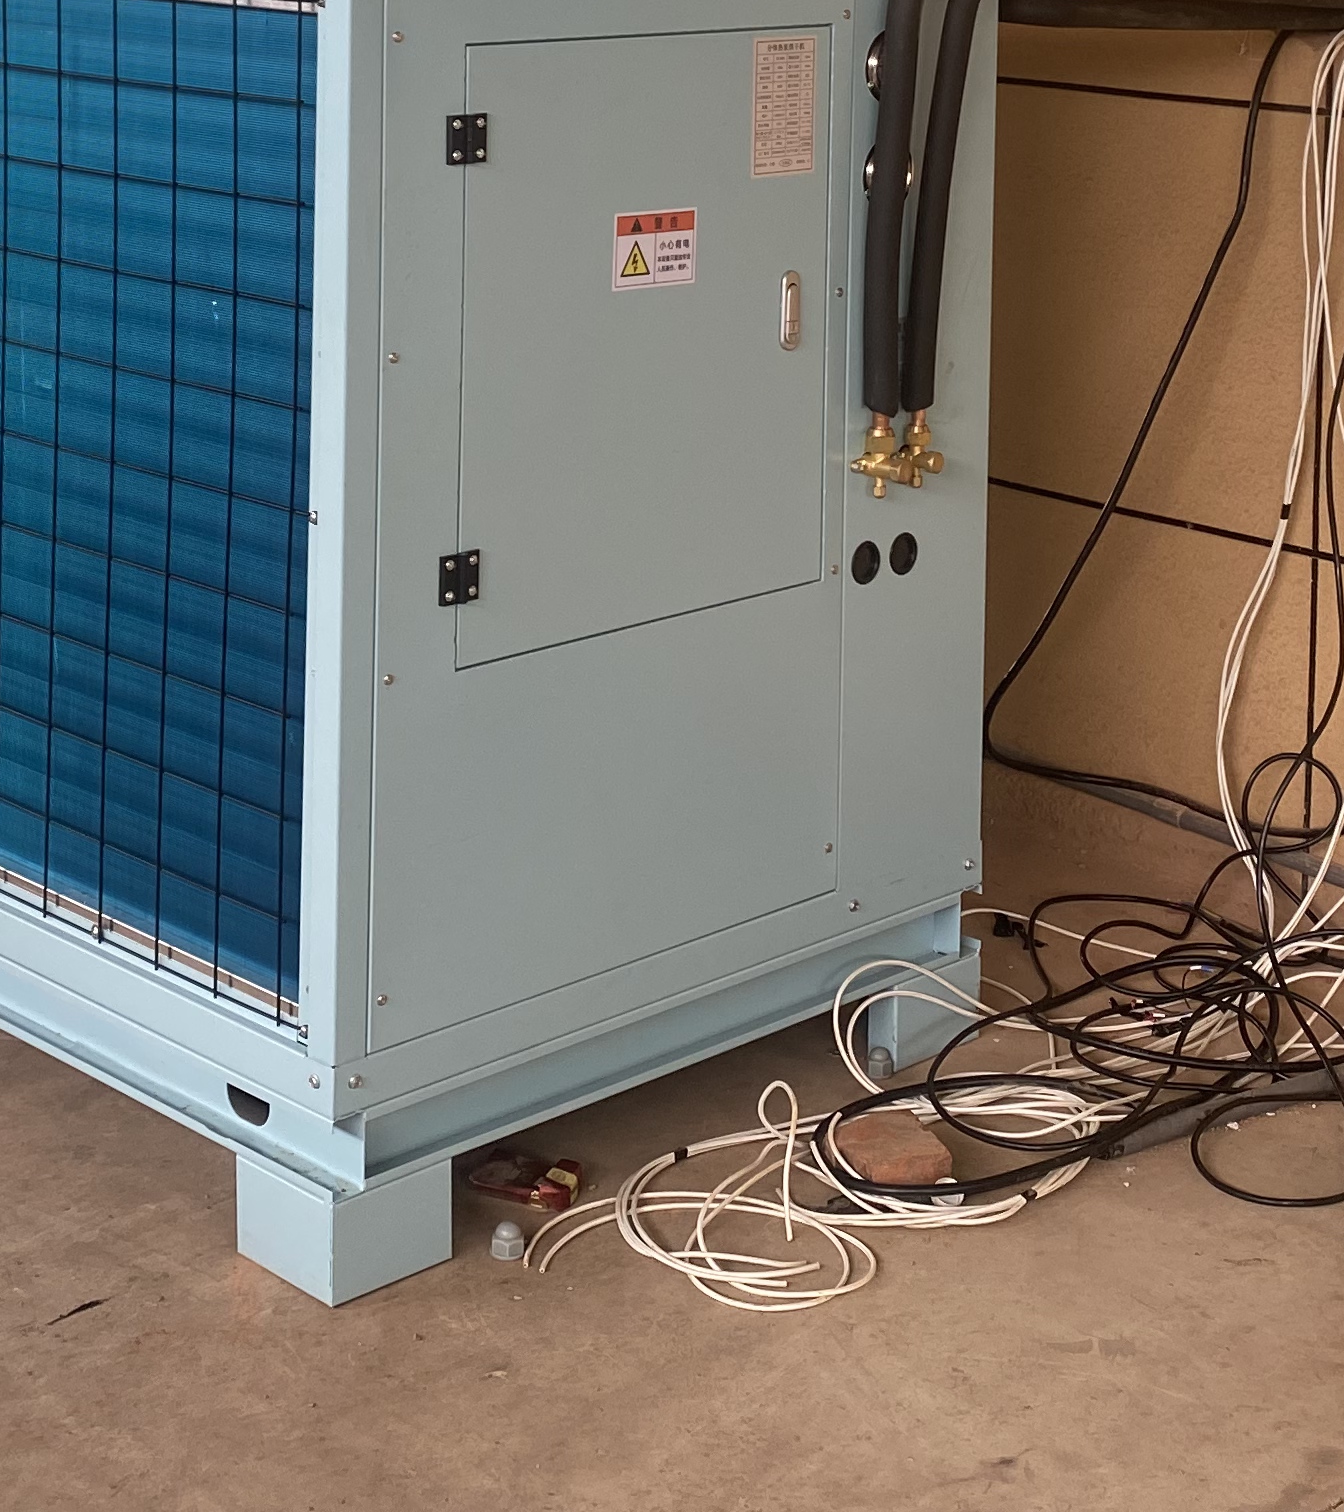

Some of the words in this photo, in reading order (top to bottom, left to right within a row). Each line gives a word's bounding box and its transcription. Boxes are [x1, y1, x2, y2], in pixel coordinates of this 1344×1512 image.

[654, 216, 678, 229] 警告
[659, 239, 690, 251] 小心有电
